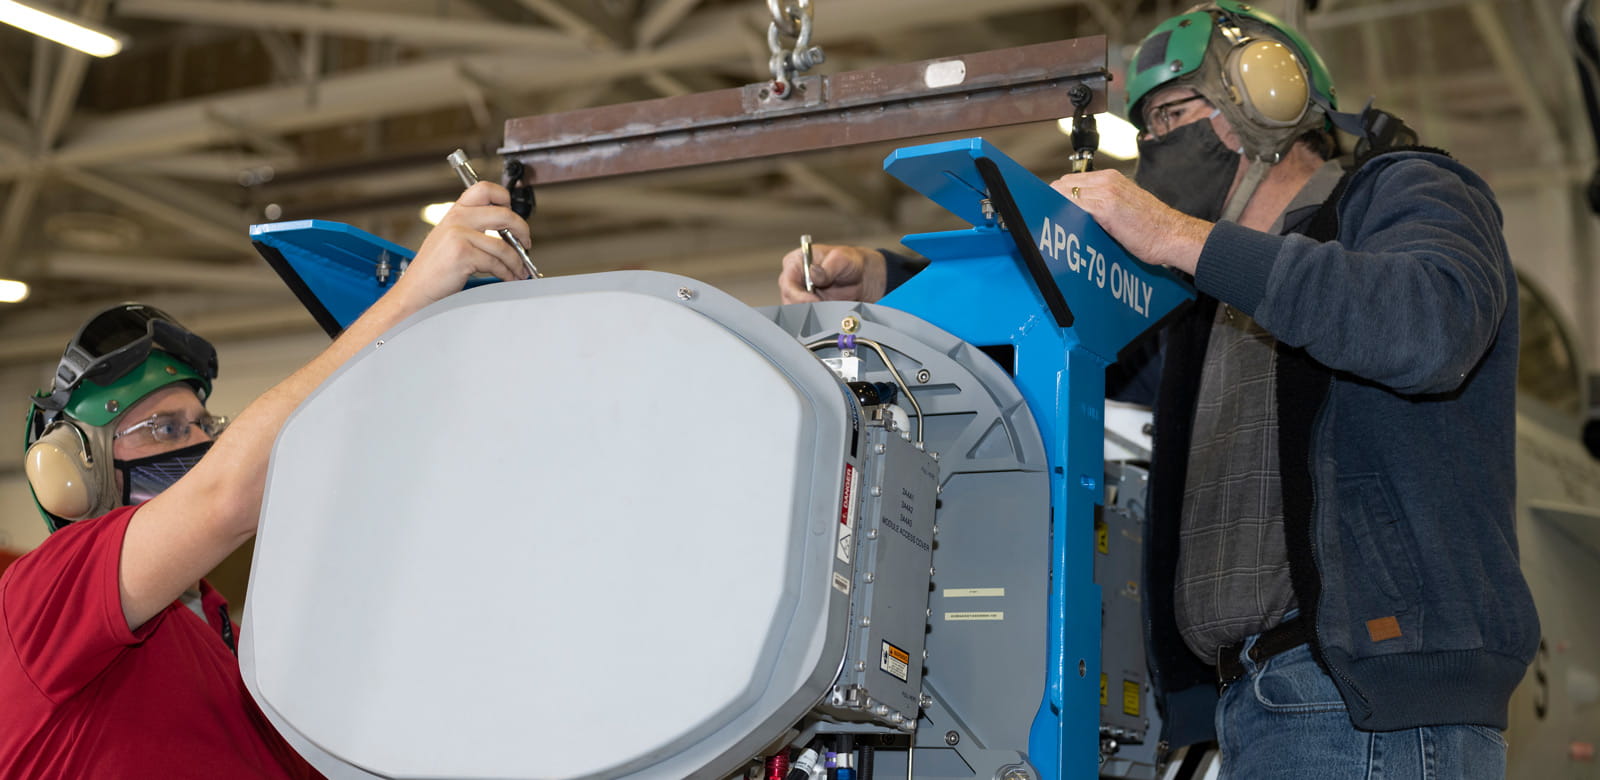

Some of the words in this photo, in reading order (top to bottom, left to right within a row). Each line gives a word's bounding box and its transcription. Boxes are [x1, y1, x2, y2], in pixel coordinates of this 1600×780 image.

[1039, 216, 1106, 289] APG-79
[1110, 262, 1153, 318] ONLY
[843, 469, 852, 508] DANGER
[882, 516, 899, 532] MODULE
[900, 528, 916, 543] ACCESS
[916, 537, 929, 551] COVER
